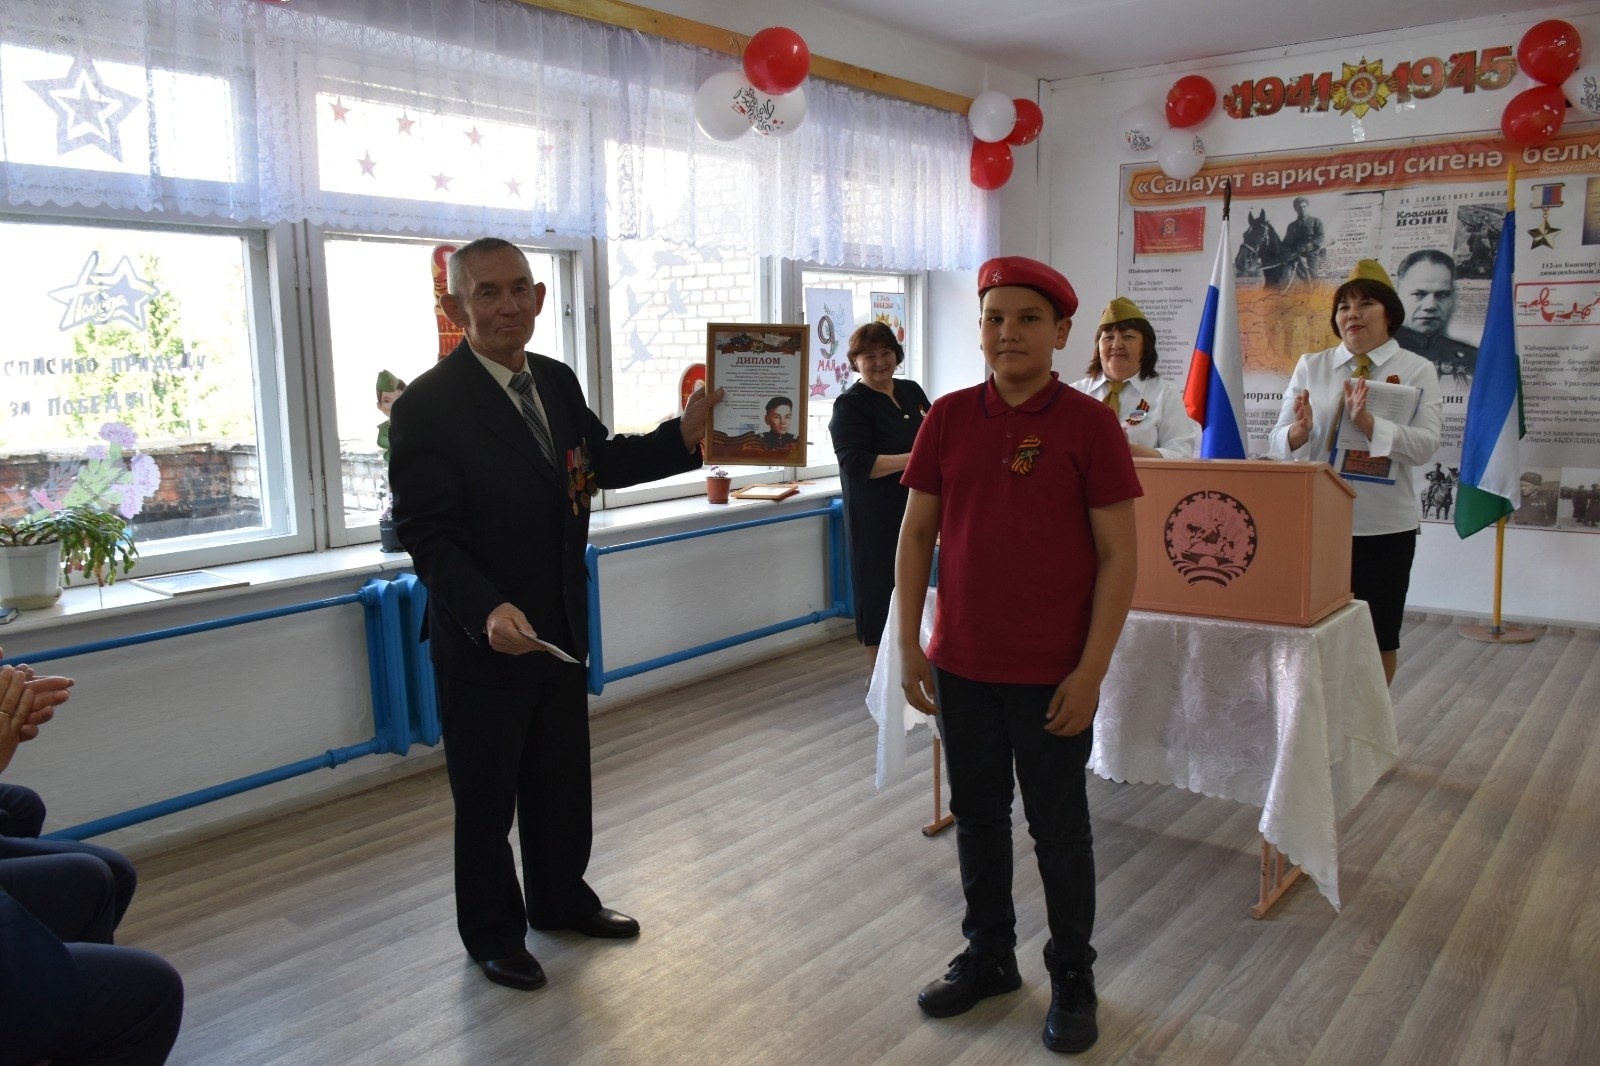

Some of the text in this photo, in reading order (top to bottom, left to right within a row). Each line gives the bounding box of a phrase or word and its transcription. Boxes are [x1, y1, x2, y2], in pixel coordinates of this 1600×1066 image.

[1392, 46, 1512, 103] 1945
[1237, 72, 1333, 118] 1941
[1136, 173, 1245, 194] «Салауат
[1522, 141, 1600, 164] белм
[1479, 190, 1507, 198] ПОБЕД
[817, 315, 836, 359] 9
[735, 356, 781, 365] ДИПЛОМ
[817, 359, 836, 372] МАЯ
[1243, 392, 1283, 402] морато
